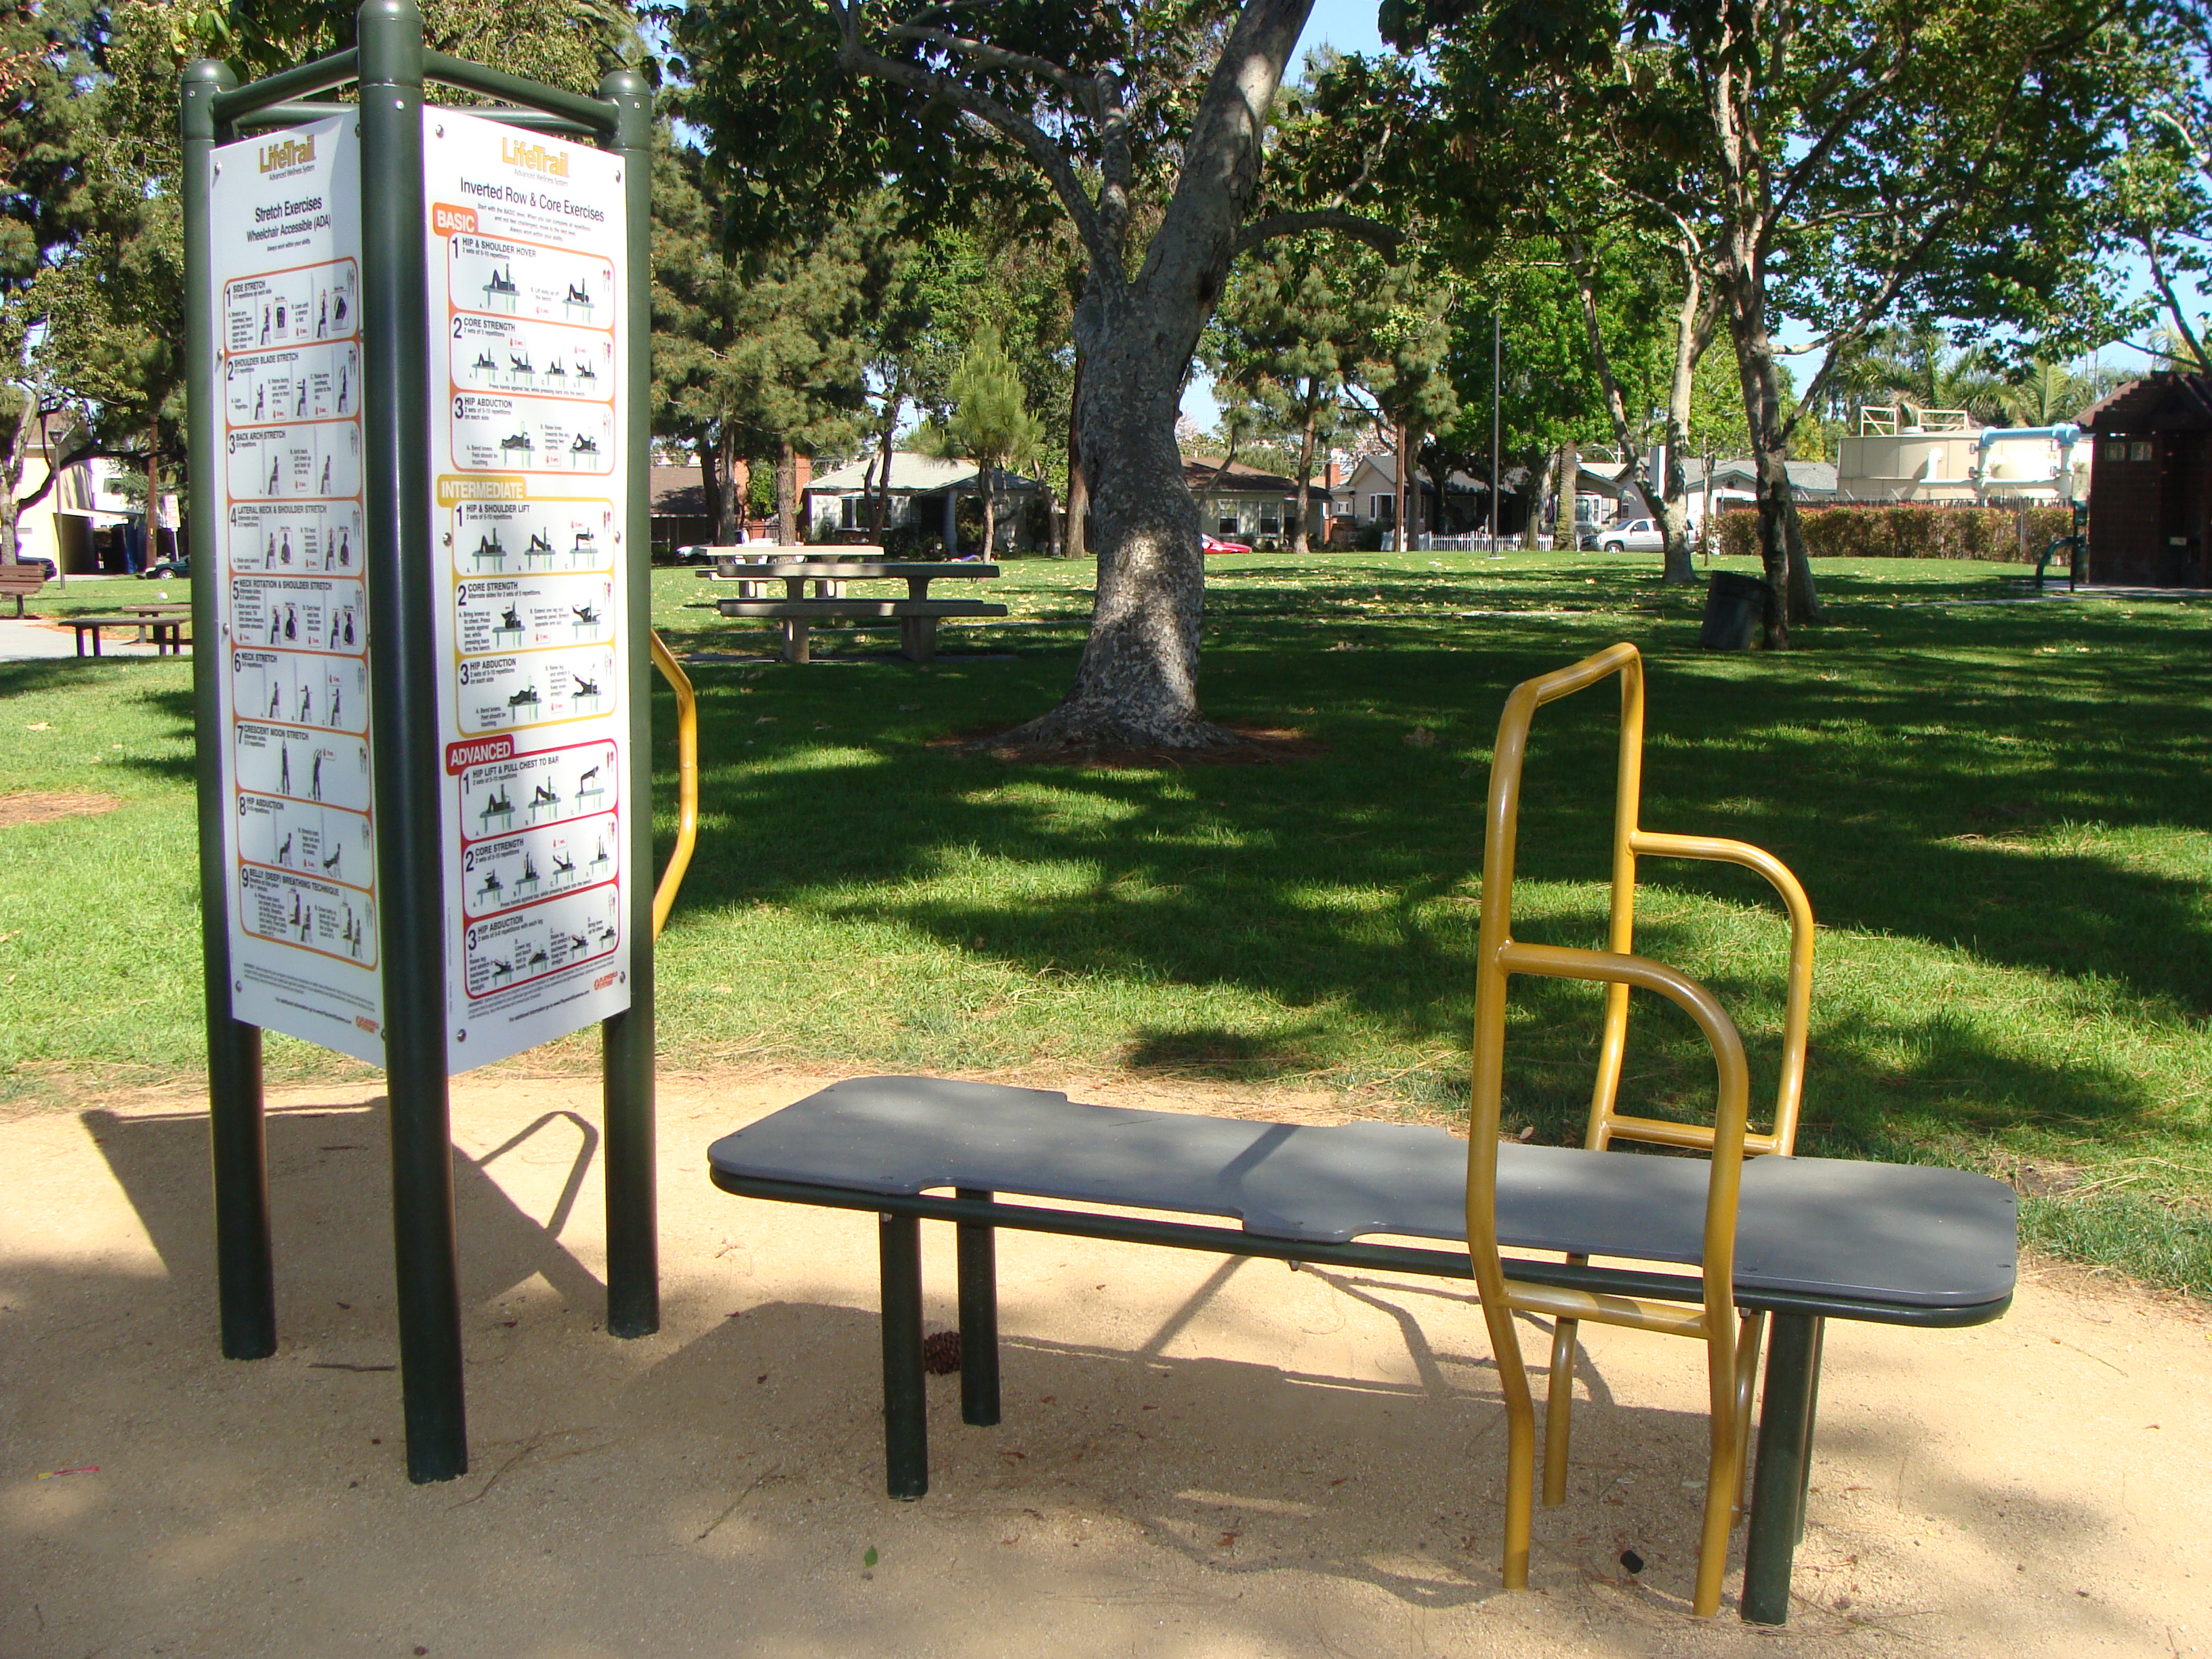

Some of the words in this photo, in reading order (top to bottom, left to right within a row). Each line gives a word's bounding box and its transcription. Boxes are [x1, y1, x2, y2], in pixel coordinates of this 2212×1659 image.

[260, 135, 316, 173] LifeTrail
[503, 137, 569, 178] LifeTrail
[514, 169, 535, 179] Advanced
[537, 173, 553, 184] Wellness
[555, 178, 568, 186] System
[255, 203, 282, 222] Stretch
[285, 197, 322, 216] Exercises
[461, 177, 502, 200] Inverted
[506, 186, 527, 205] Row
[531, 194, 536, 207] &
[540, 194, 561, 213] Core
[565, 200, 604, 222] Exercises
[247, 226, 279, 243] Wheelchair
[281, 219, 312, 236] Accessible
[314, 214, 331, 231] (ADA)
[437, 210, 474, 233] BASIC
[453, 237, 457, 258] 1
[463, 238, 473, 247] HIP
[481, 241, 514, 254] SHOULDER
[517, 247, 535, 258] HOVER
[226, 287, 230, 307] 1
[233, 283, 243, 293] SIDE
[245, 281, 265, 291] STRETCH
[454, 318, 462, 338] 2
[464, 318, 481, 328] CORE
[483, 320, 515, 331] STRENGTH
[228, 361, 233, 381] 2
[234, 357, 259, 367] SHOULDER
[260, 355, 275, 364] BLADE
[276, 352, 298, 363] STRETCH
[455, 398, 464, 419] 3
[478, 398, 512, 408] ABDUCTION
[230, 434, 235, 454] 3
[237, 432, 248, 441] BACK
[264, 431, 285, 439] STRETCH
[442, 481, 524, 499] INTERMEDIATE
[230, 508, 237, 527] 4
[278, 506, 304, 514] SHOULDER
[457, 506, 462, 527] 1
[479, 505, 483, 513] &
[233, 581, 239, 600] 5
[283, 581, 309, 590] SHOULDER
[310, 581, 332, 590] STRETCH
[458, 585, 467, 606] 2
[468, 583, 485, 592] CORE
[487, 582, 518, 591] STRENGTH
[235, 653, 241, 672] 6
[255, 654, 277, 663] STRETCH
[460, 664, 469, 685] 3
[470, 662, 480, 670] HIP
[483, 658, 516, 669] ABDUCTION
[238, 725, 243, 744] 7
[245, 725, 268, 735] CRESCENT
[271, 728, 285, 737] MOON
[287, 731, 308, 740] STRETCH
[451, 741, 510, 766] ADVANCED
[464, 774, 469, 794] 1
[473, 770, 483, 778] HIP
[485, 766, 497, 777] LIFT
[504, 763, 518, 773] PULL
[520, 760, 537, 769] CHEST
[548, 756, 559, 764] BAR
[240, 796, 246, 816] 8
[256, 799, 284, 810] ABDUCTION
[466, 851, 474, 872] 2
[475, 846, 491, 856] CORE
[493, 838, 523, 852] STRENGTH
[242, 868, 248, 887] 9
[249, 869, 264, 878] BELLY
[266, 872, 281, 882] (DEEP)
[283, 876, 310, 889] BREATHING
[312, 882, 339, 896] TECHNIQUE
[468, 930, 476, 950] 3
[478, 925, 488, 934] HIP
[490, 916, 523, 931] ABDUCTION
